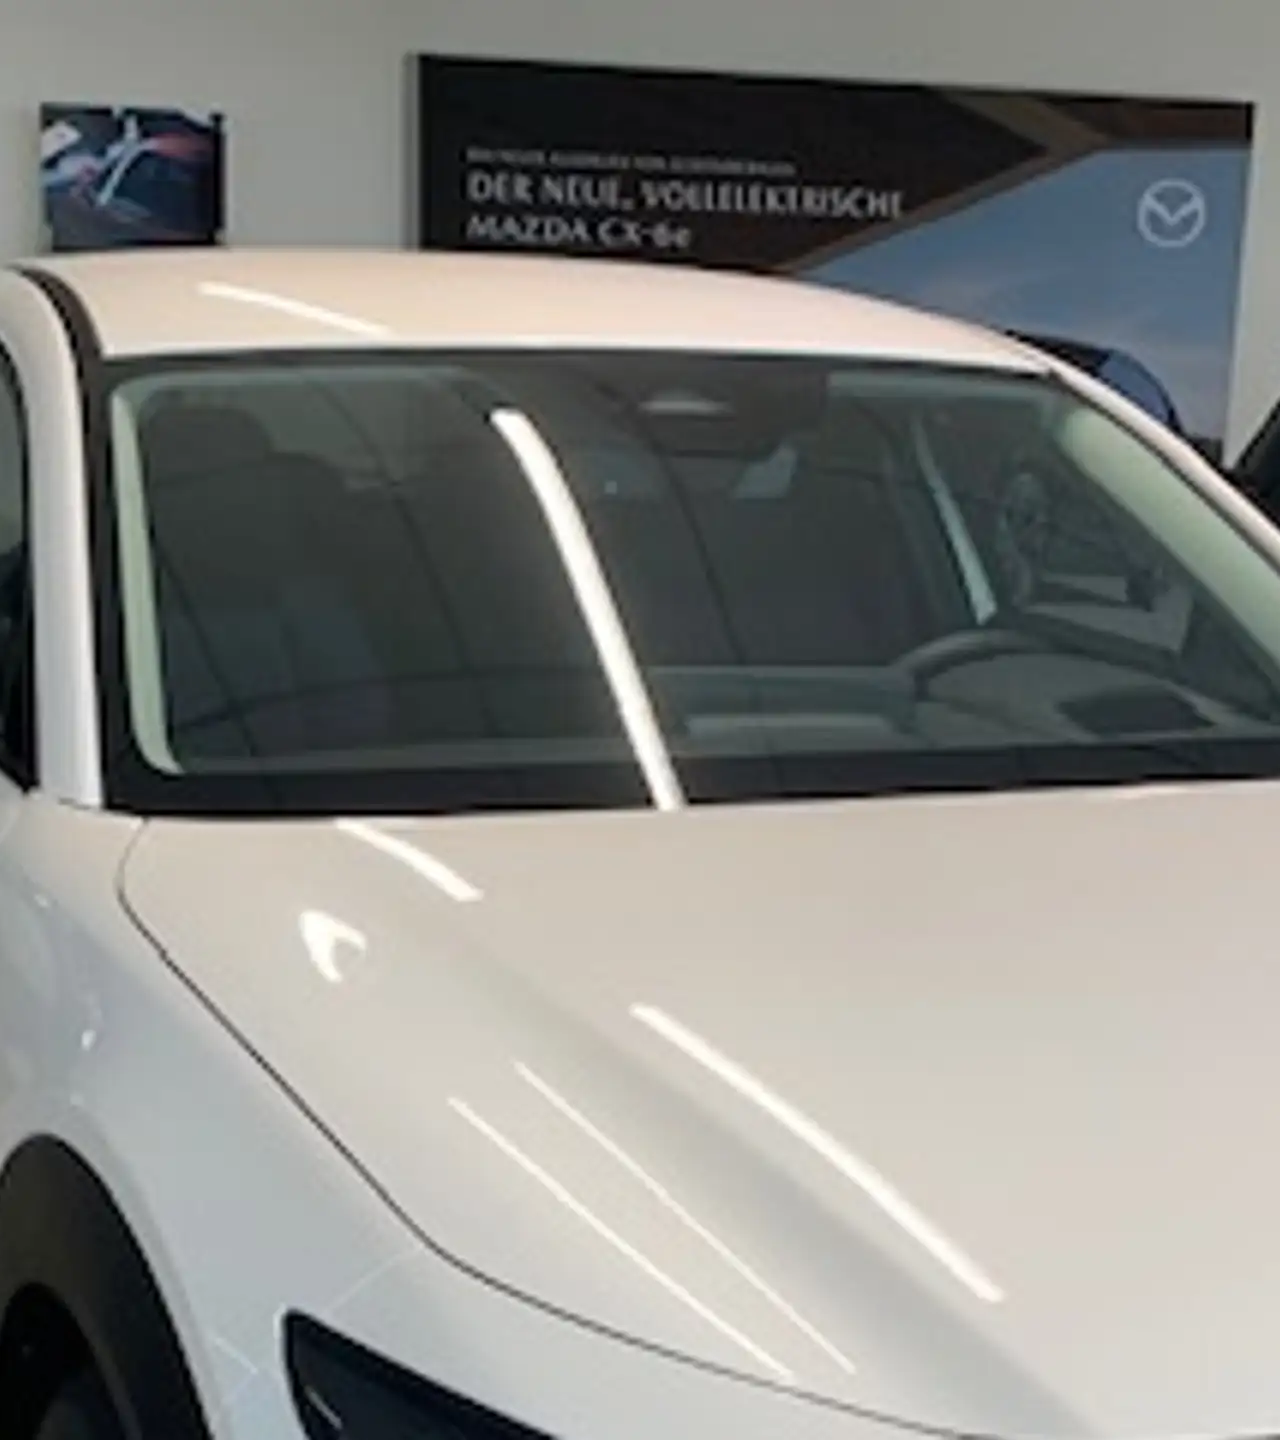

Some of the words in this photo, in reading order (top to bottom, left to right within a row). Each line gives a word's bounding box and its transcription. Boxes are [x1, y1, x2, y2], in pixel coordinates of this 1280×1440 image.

[469, 169, 533, 204] DER
[640, 179, 905, 218] VOLLELEKTRISCHE
[468, 213, 591, 244] MAZDA
